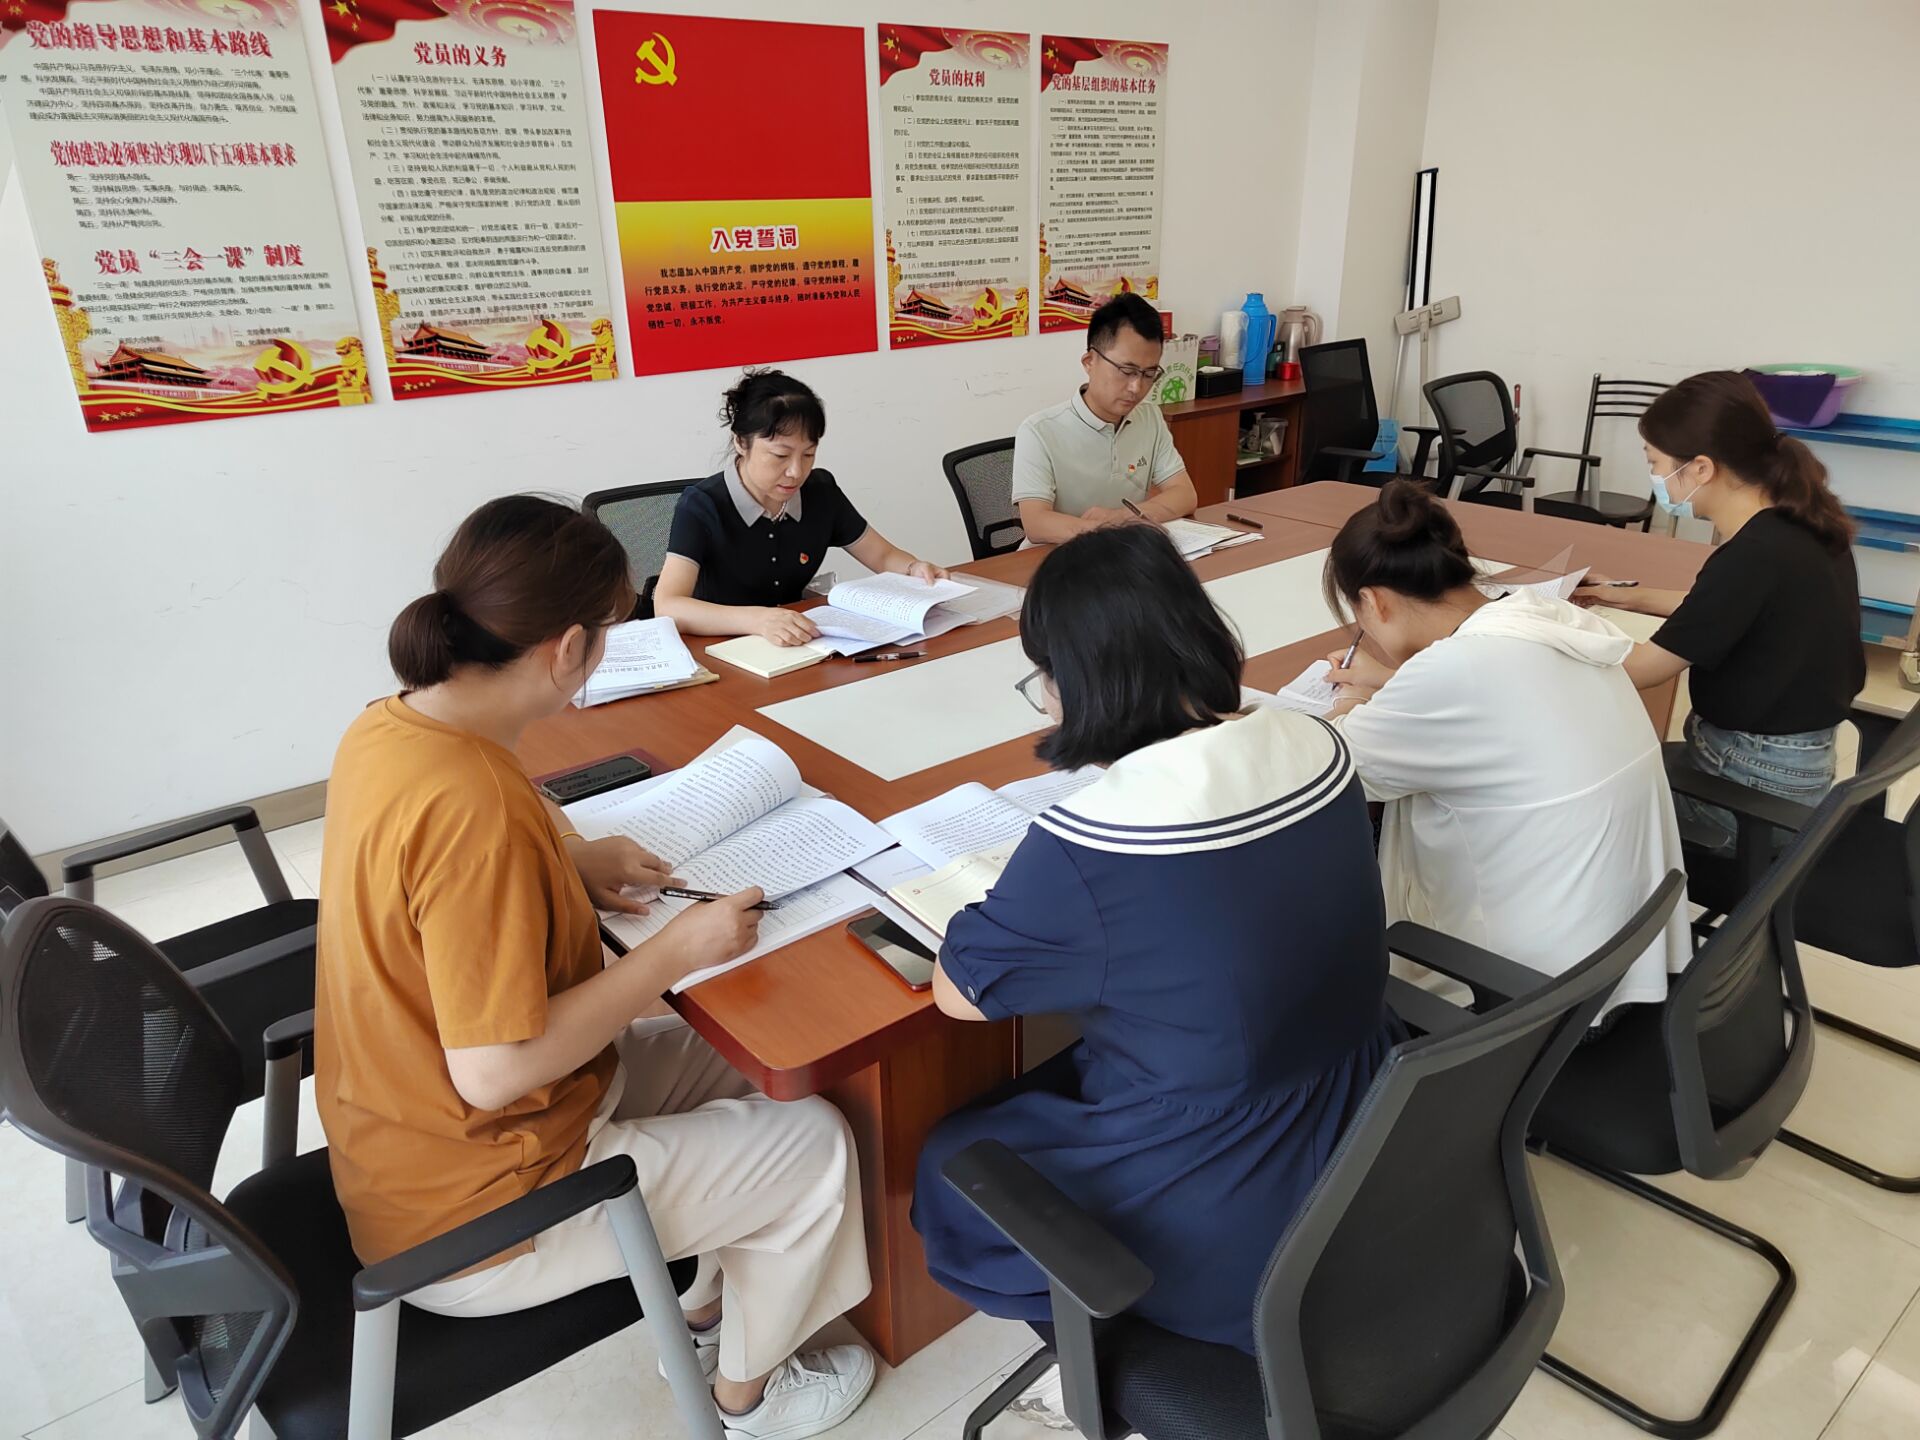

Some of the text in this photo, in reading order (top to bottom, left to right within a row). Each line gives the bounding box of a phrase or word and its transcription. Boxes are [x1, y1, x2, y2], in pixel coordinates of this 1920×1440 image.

[26, 20, 273, 58] 党的指导思想和基本路线
[413, 41, 507, 67] 党员的义务
[929, 69, 985, 87] 党员的权利
[1052, 74, 1156, 94] 党的基层组织的基本任务
[50, 140, 298, 167] 党的建设必须坚决实现以下五项基本要求
[711, 227, 798, 251] 入党誓词
[94, 243, 304, 275] 党员“三会一课”制度
